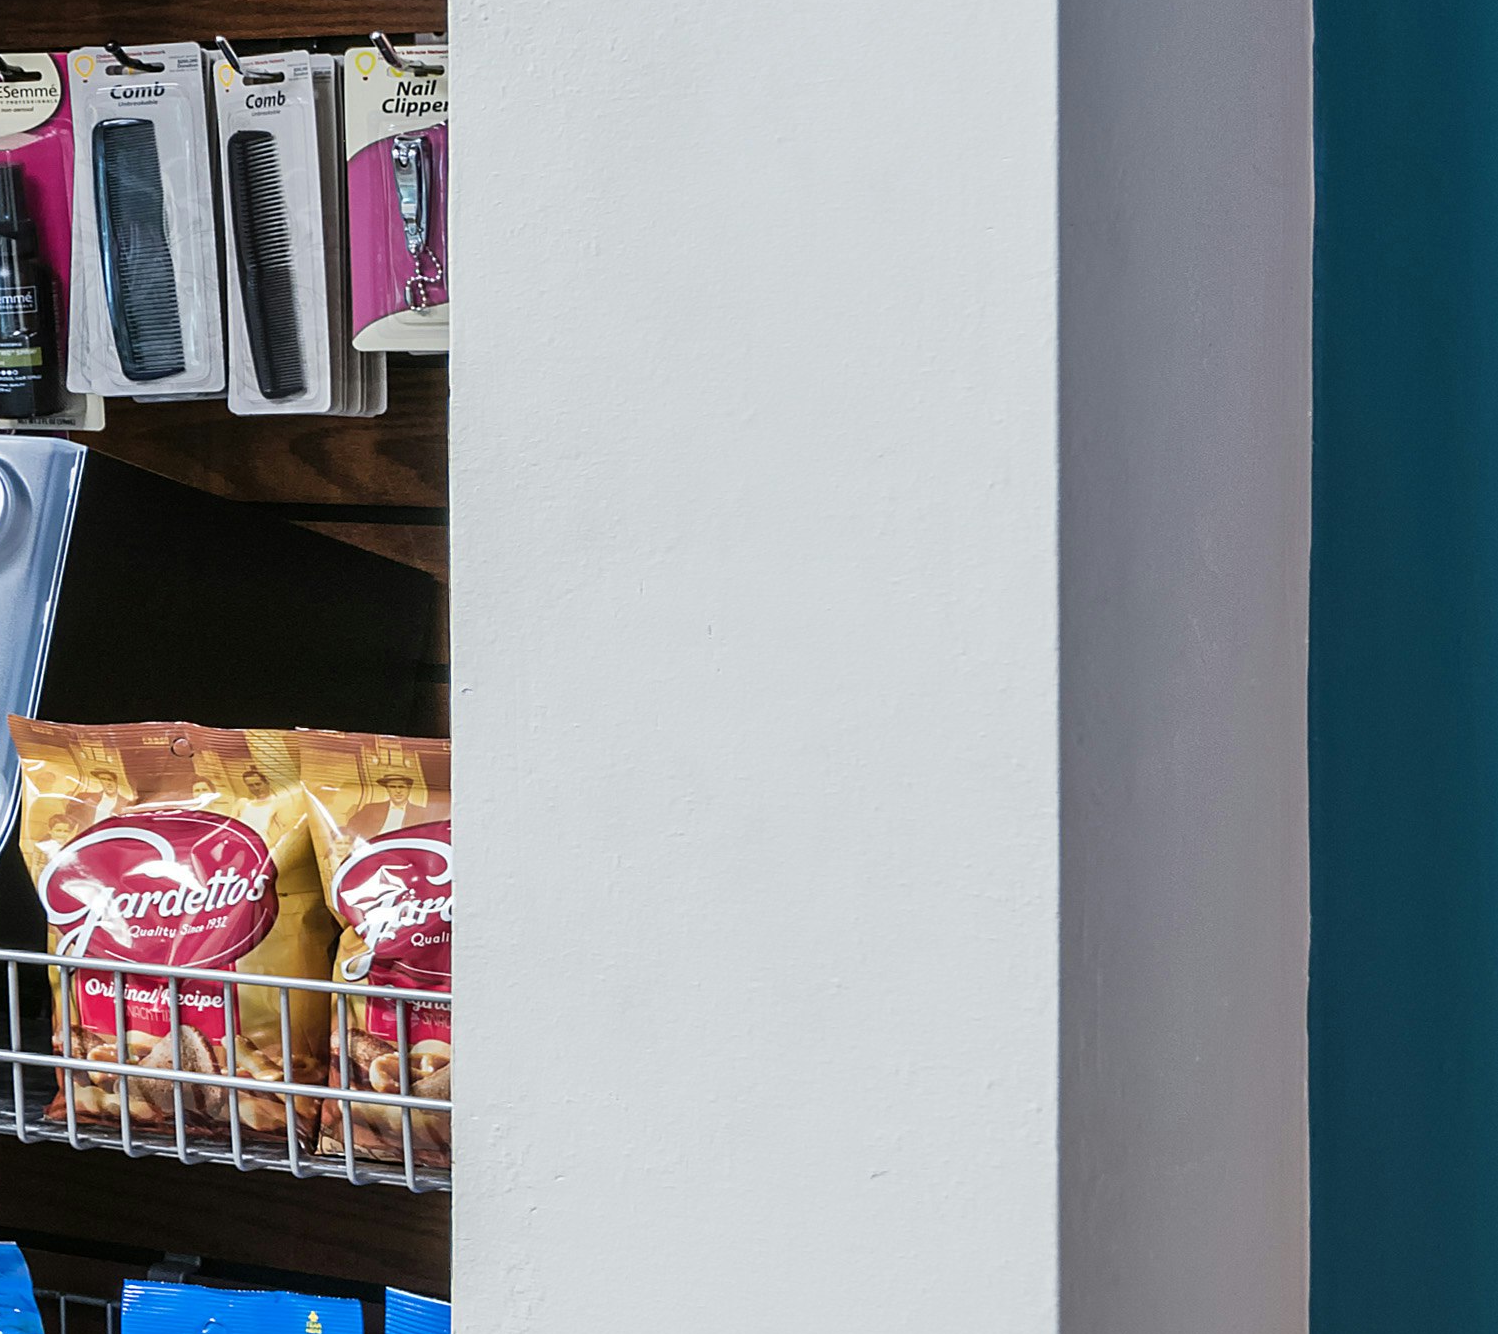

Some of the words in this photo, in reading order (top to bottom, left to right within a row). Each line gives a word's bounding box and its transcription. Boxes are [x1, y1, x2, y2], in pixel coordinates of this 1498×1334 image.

[109, 81, 165, 100] Comb
[396, 79, 437, 96] Nail
[245, 90, 286, 109] Comb
[38, 827, 271, 960] Gardetto's
[127, 923, 177, 940] Quality
[180, 923, 205, 936] Since
[205, 915, 228, 931] 1932
